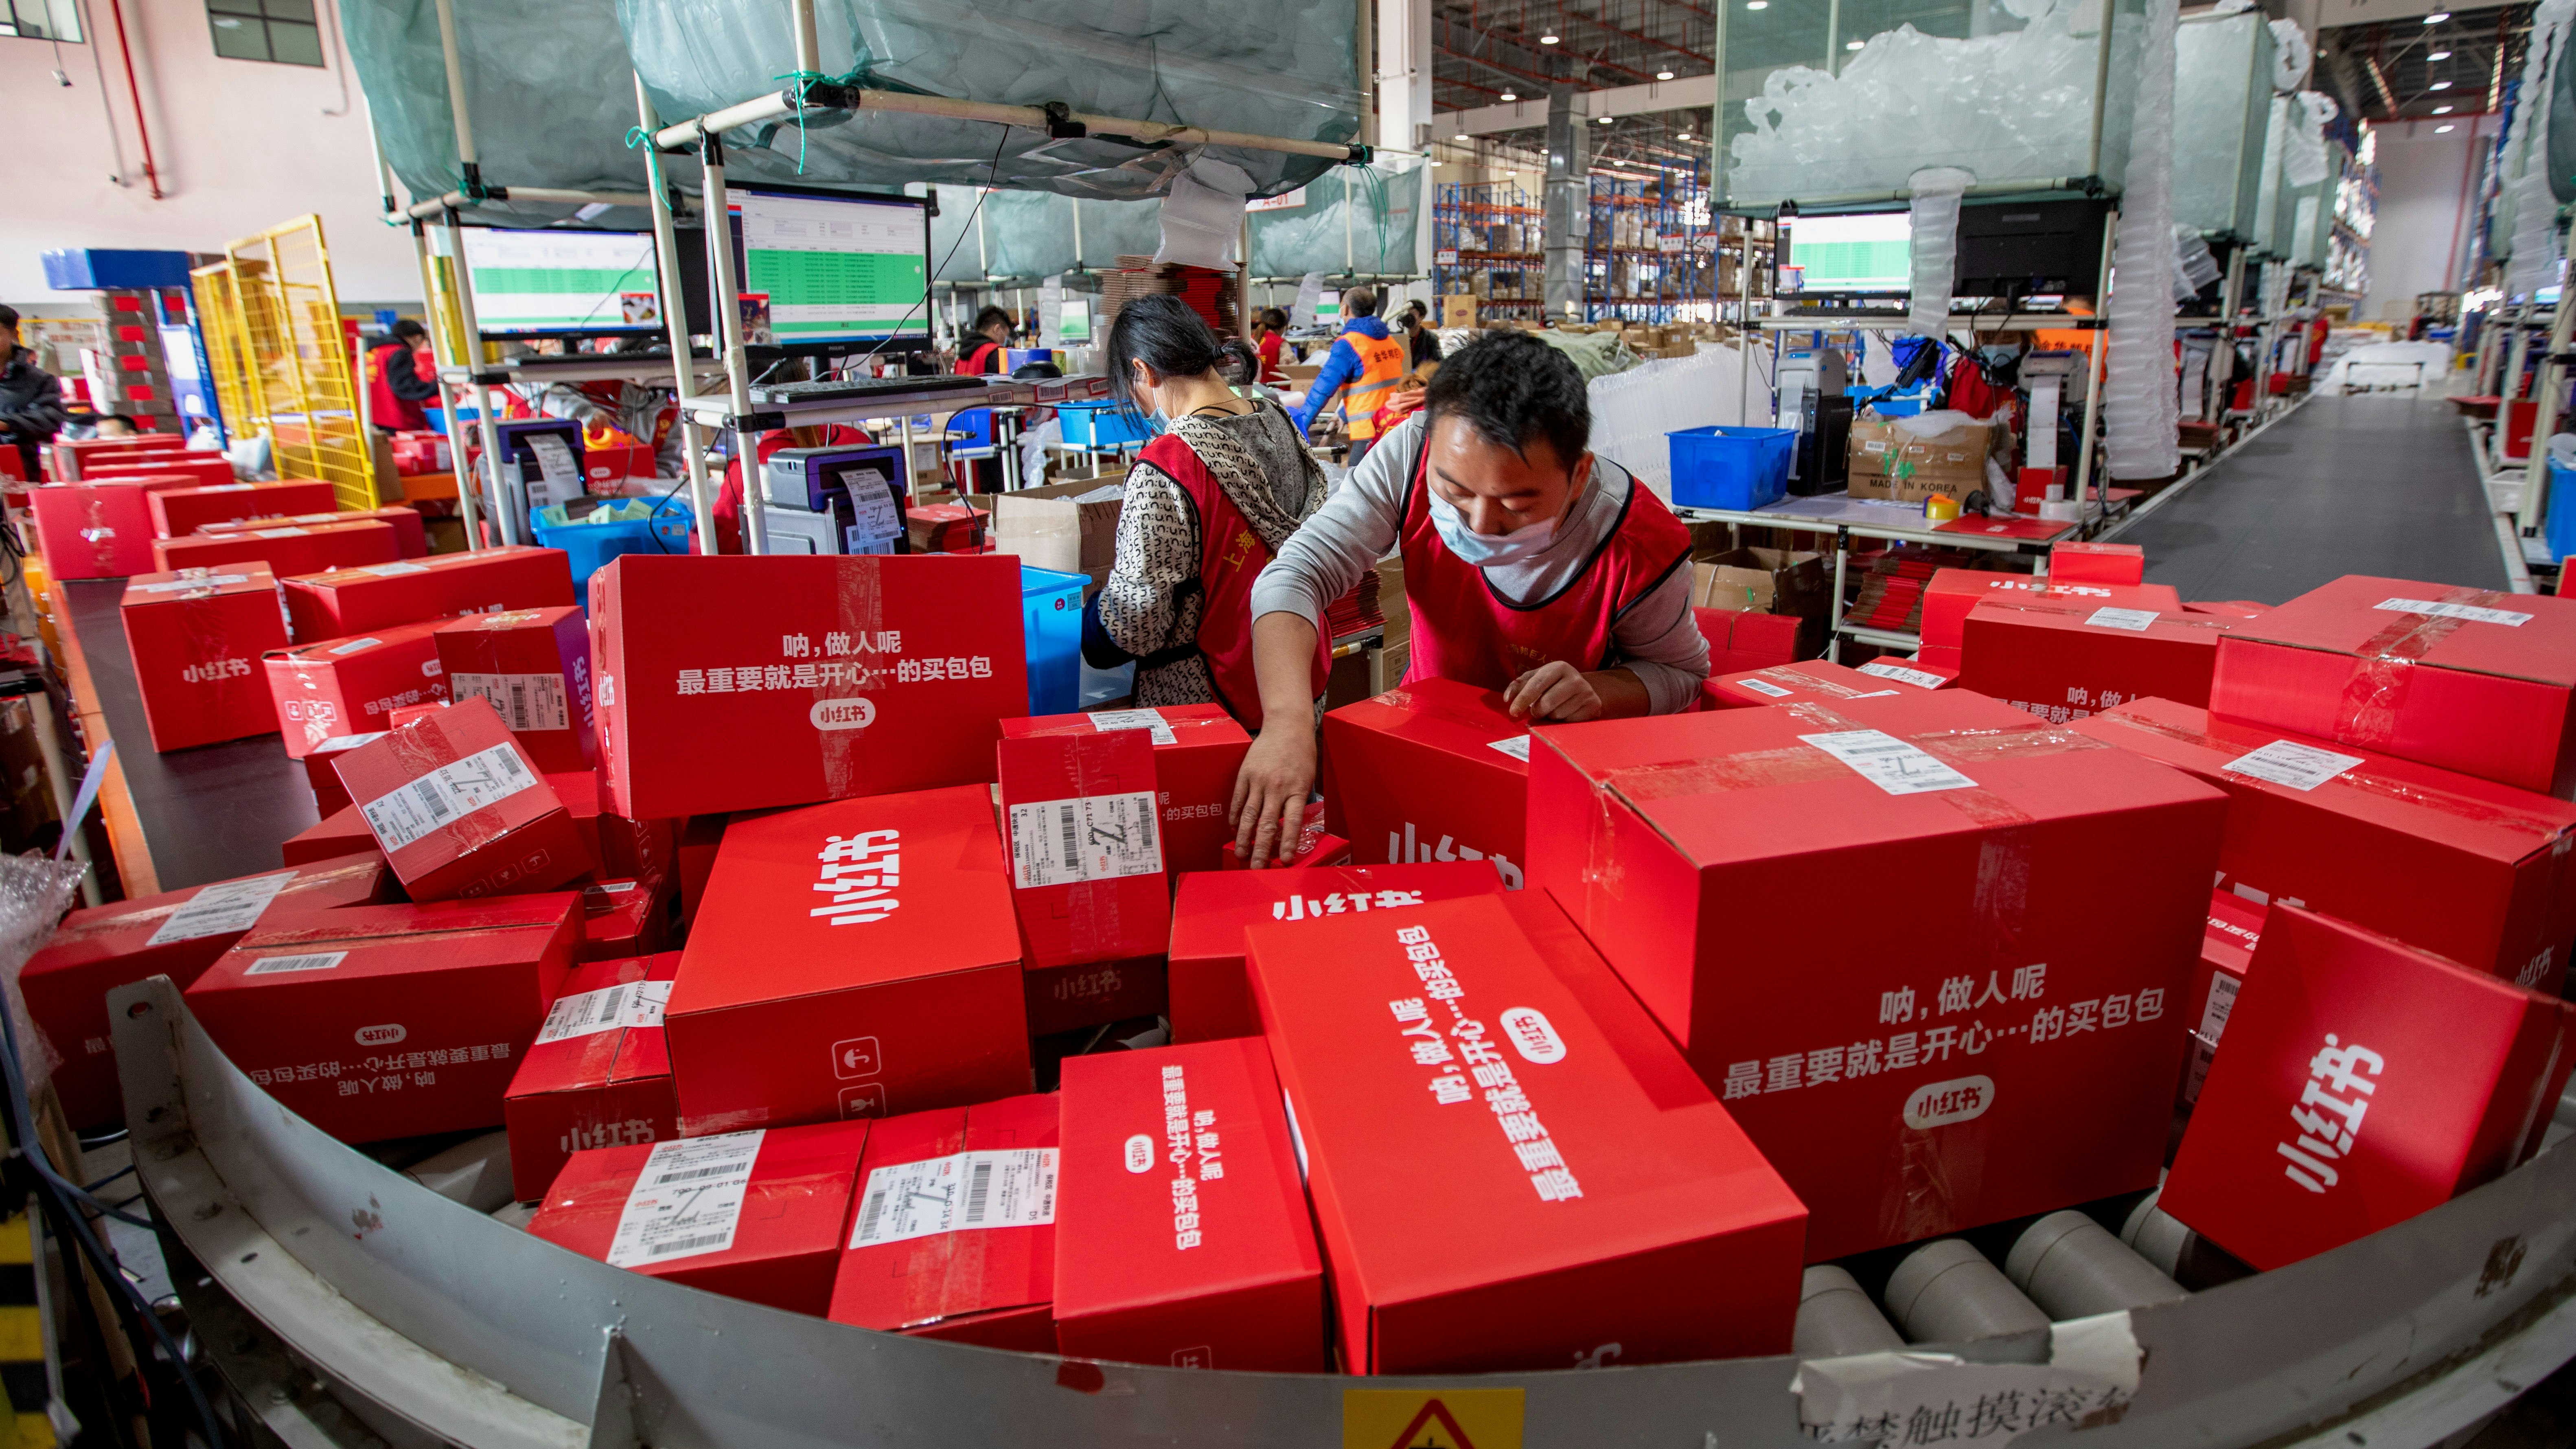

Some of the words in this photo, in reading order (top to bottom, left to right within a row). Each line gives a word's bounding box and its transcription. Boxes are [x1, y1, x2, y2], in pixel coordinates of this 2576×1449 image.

[1904, 481, 1914, 490] IN
[1921, 483, 1958, 493] KOREA
[1222, 529, 1255, 572] 上海
[783, 630, 902, 658] 呐，做人呢
[183, 658, 251, 683] 小红书
[676, 655, 993, 695] 最重要就是开心…的买包包
[572, 656, 594, 727] 小红书
[820, 704, 867, 724] 小红书
[1021, 809, 1027, 818] 32
[1085, 802, 1092, 811] 73
[810, 829, 900, 926] 小红书
[1054, 967, 1122, 1000] 小红书
[1879, 963, 2047, 1025] 呐，做人呢
[362, 1028, 399, 1041] 小红书
[1389, 997, 1472, 1105] 呐，做人呢
[1514, 1015, 1554, 1055] 小红书
[1723, 988, 2164, 1100] 最重要就是开心…的买包包
[1396, 925, 1583, 1201] 最重要就是开心…的买包包
[337, 1071, 436, 1096] 呐，做人呢
[1917, 1085, 1984, 1122] 小红书
[2277, 1033, 2385, 1193] 小红书
[561, 1118, 655, 1154] 小红书
[1193, 1109, 1224, 1181] 呐，做人呢
[1132, 1140, 1147, 1170] 小红书
[1161, 1065, 1202, 1250] 最重要就是开心…的买包包
[1028, 1211, 1037, 1221] D5
